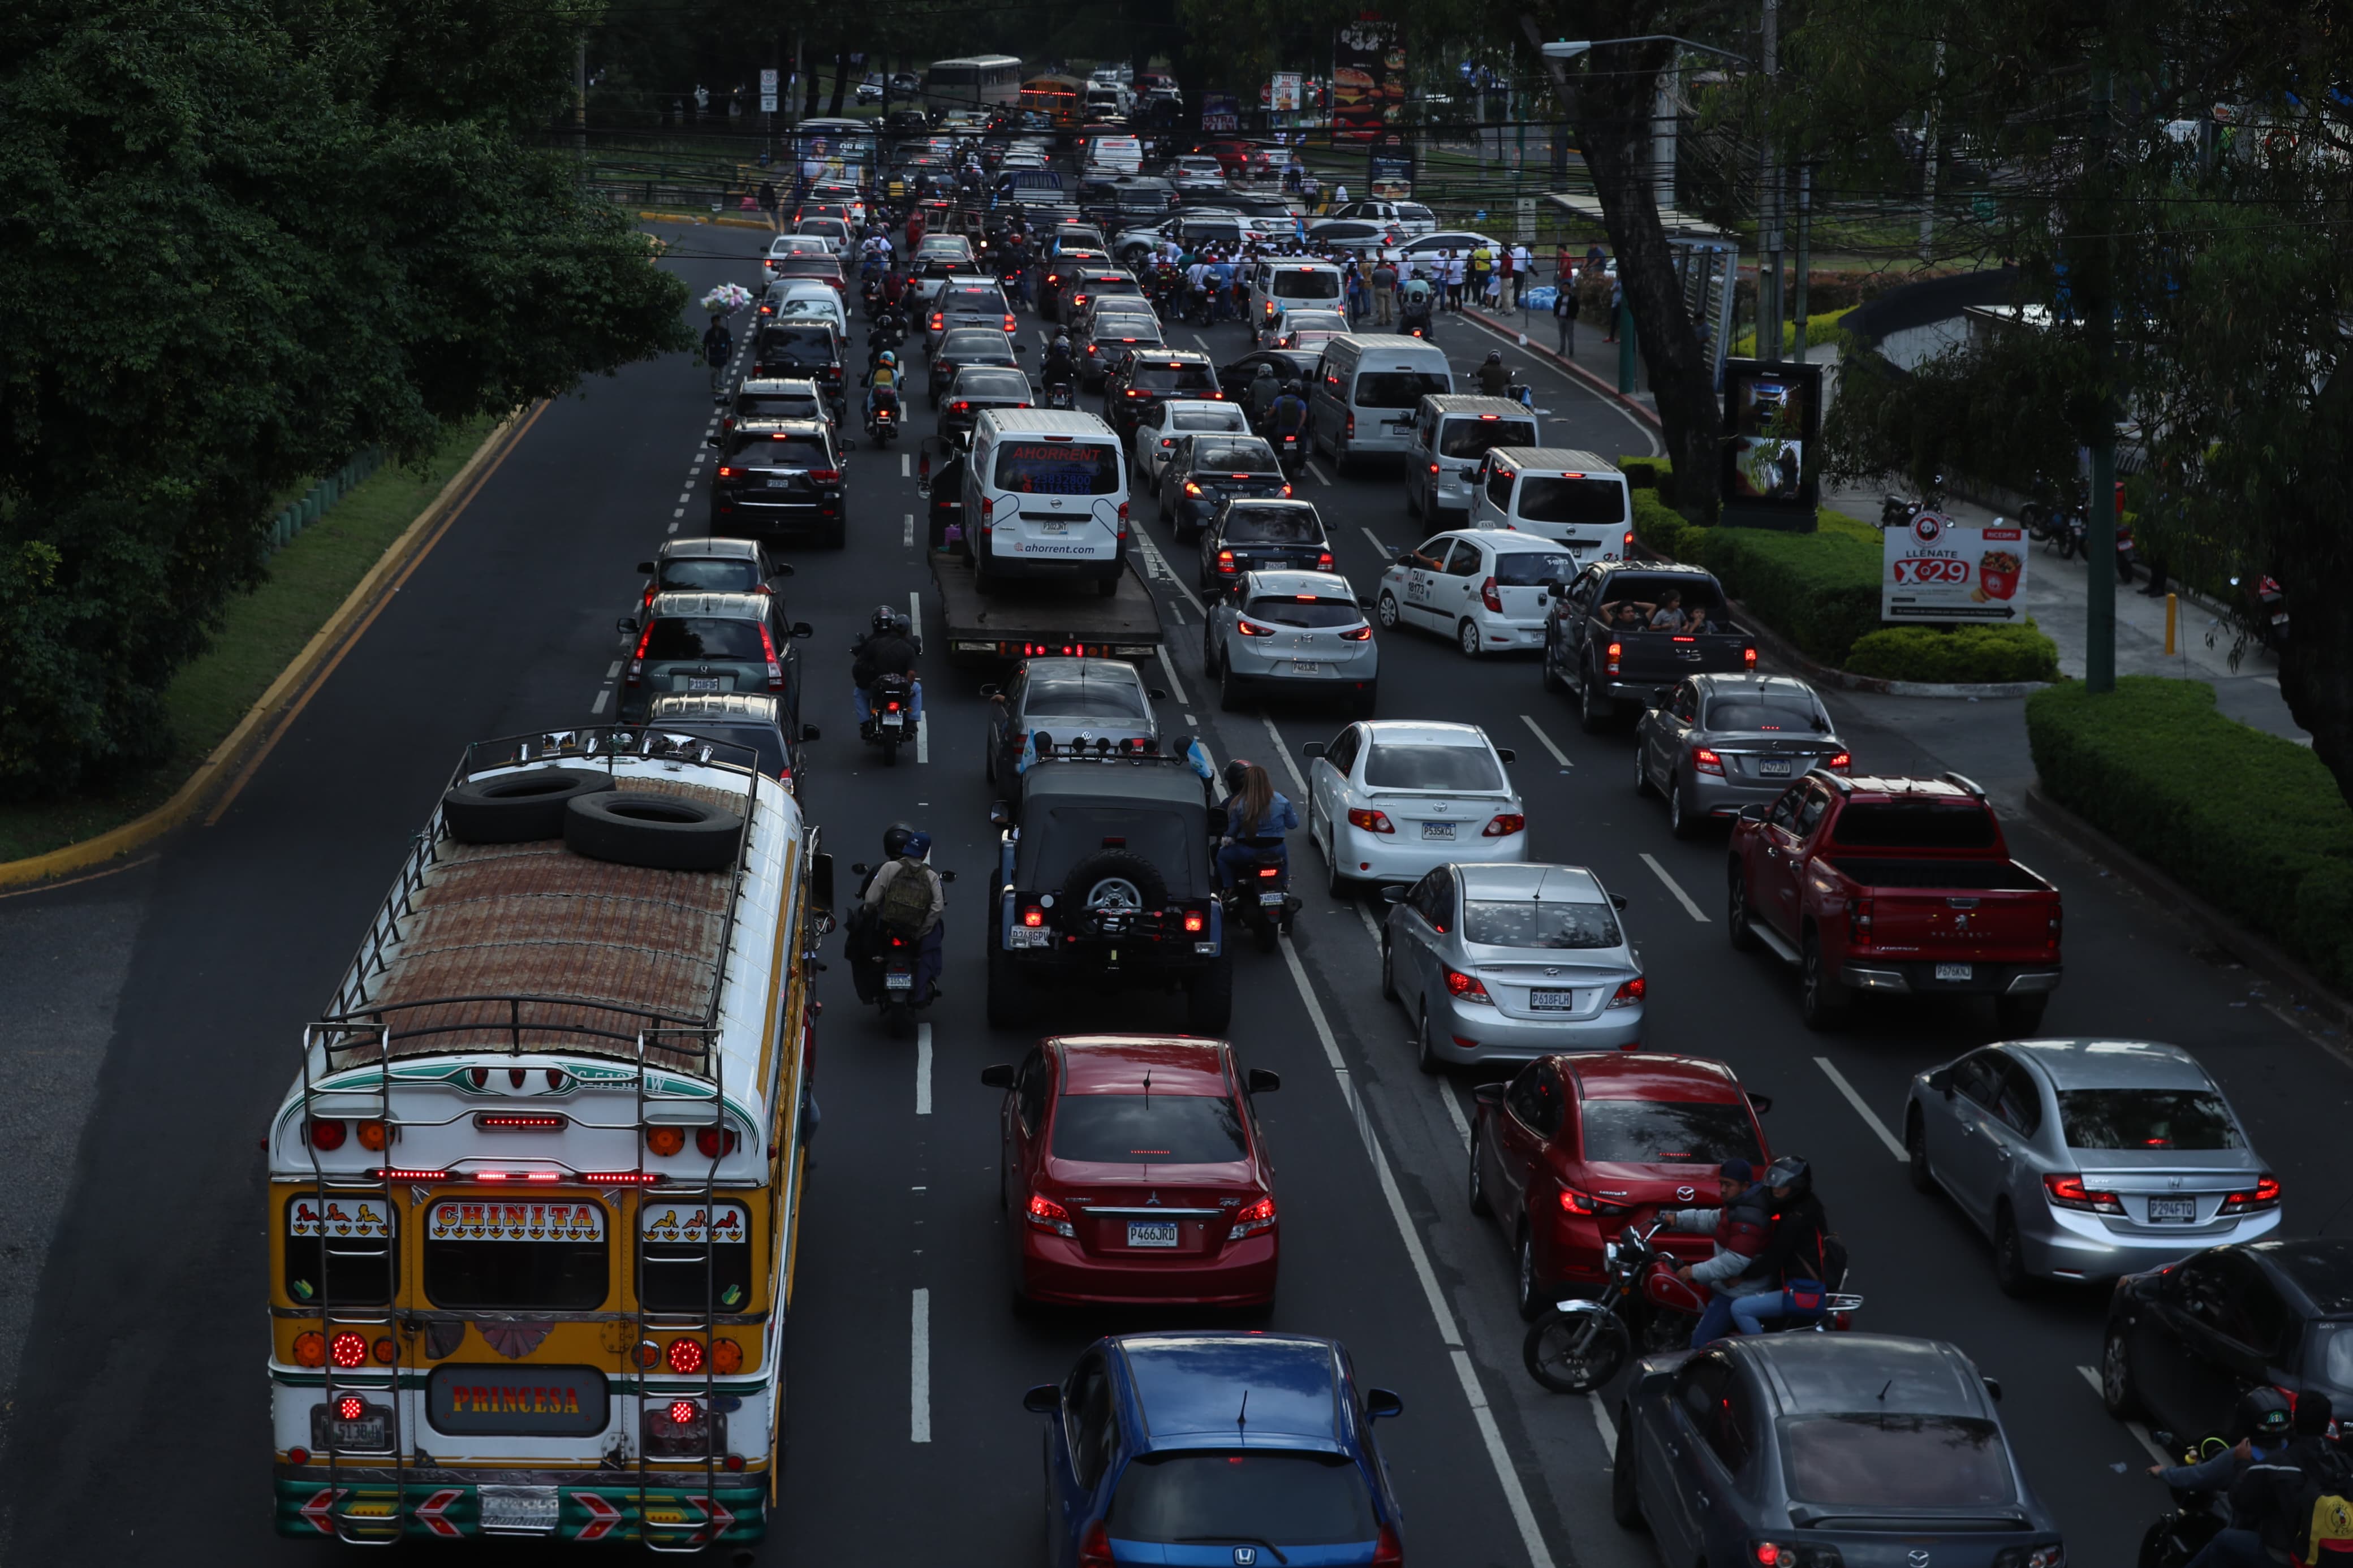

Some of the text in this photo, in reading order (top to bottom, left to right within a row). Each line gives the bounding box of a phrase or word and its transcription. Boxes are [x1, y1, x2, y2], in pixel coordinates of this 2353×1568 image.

[1012, 446, 1102, 461] AHORRENT
[1034, 474, 1091, 485] 23832800
[1025, 543, 1094, 554] ahorrent.com
[1906, 547, 1958, 559] LLÉNATE
[1412, 571, 1425, 583] TAXI
[1408, 582, 1424, 594] 18173
[1424, 827, 1454, 836] P535KCL
[1533, 994, 1570, 1005] P618FLH
[2151, 1203, 2193, 1215] P294FTQ
[437, 1204, 594, 1228] CHINITA
[1131, 1227, 1175, 1240] P466JRD
[453, 1386, 579, 1414] PRINCESA
